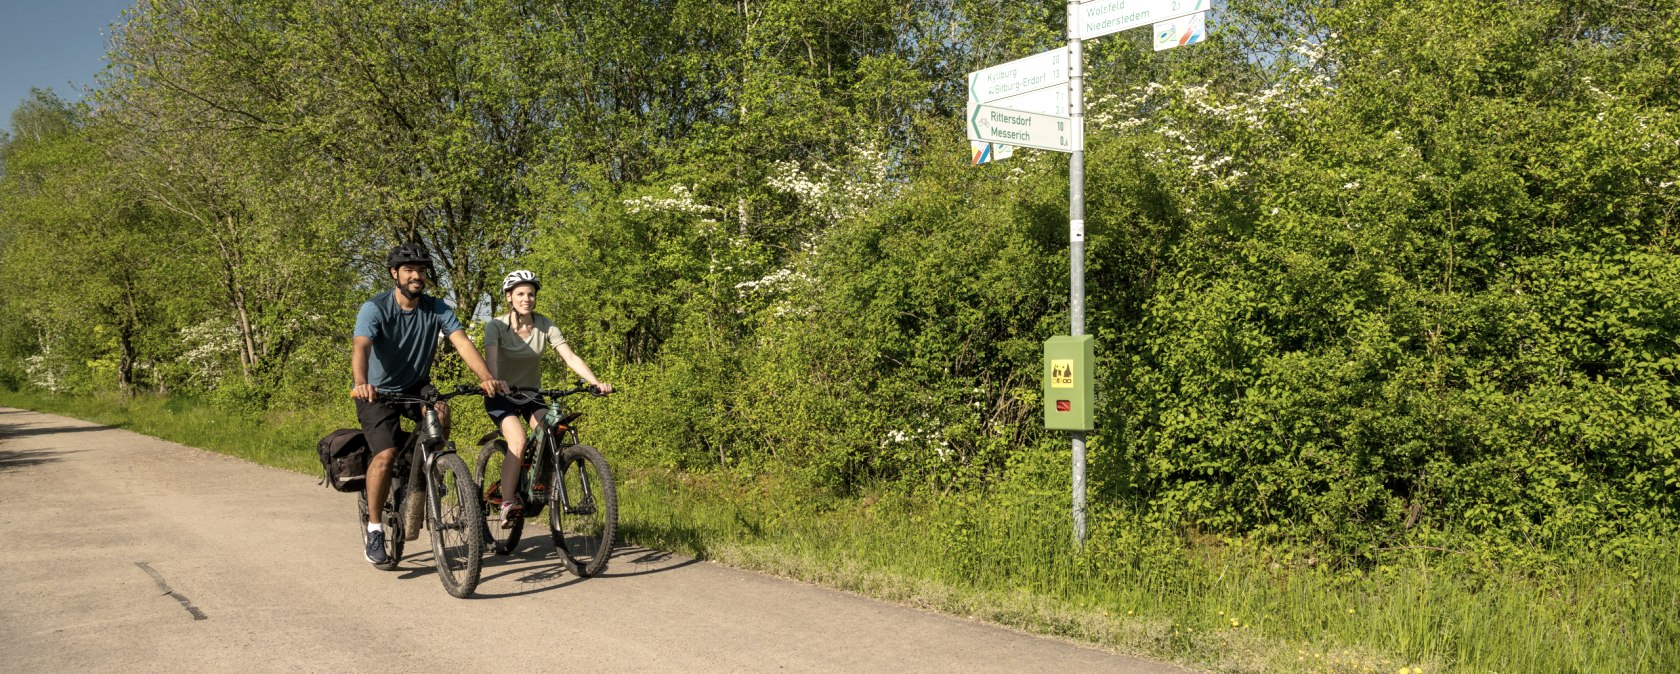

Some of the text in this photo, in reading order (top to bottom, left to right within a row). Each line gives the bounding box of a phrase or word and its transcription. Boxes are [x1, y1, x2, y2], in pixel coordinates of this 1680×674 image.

[1087, 0, 1125, 17] Wolsfeld
[1086, 10, 1149, 32] Niederstedem
[990, 111, 1064, 132] Rittersdorf 10
[991, 127, 1030, 141] Messerich
